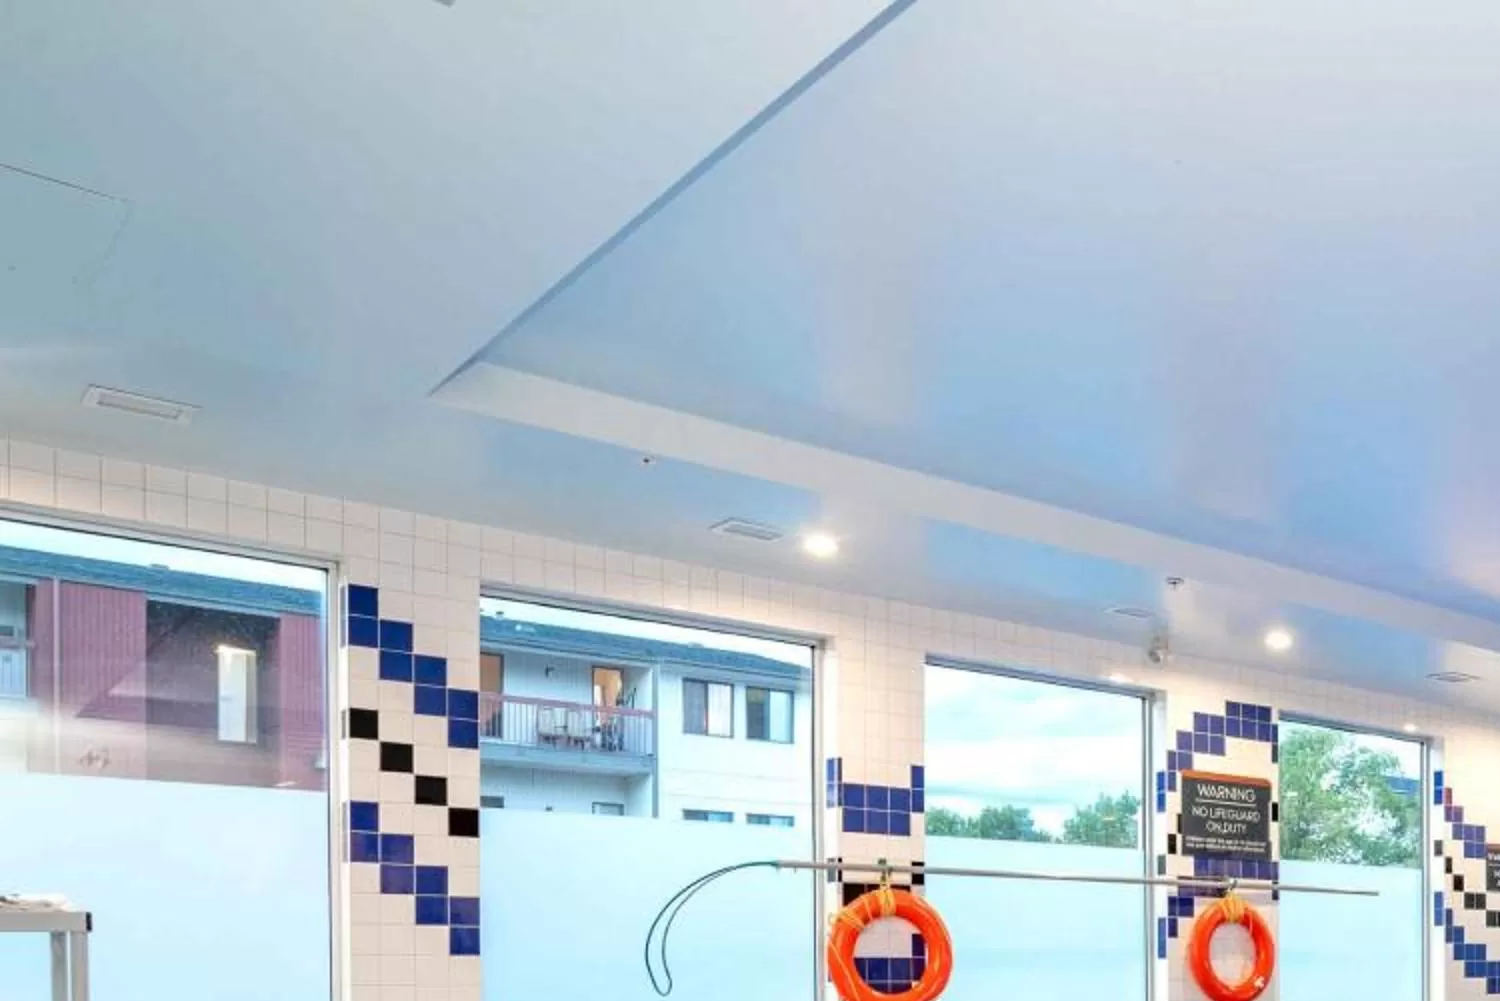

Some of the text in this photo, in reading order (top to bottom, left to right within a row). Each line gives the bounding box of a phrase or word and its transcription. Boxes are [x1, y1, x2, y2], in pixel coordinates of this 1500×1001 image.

[1196, 783, 1257, 803] WARNING
[1191, 805, 1261, 823] NO LIFEGUARD
[1222, 821, 1248, 834] DUTY
